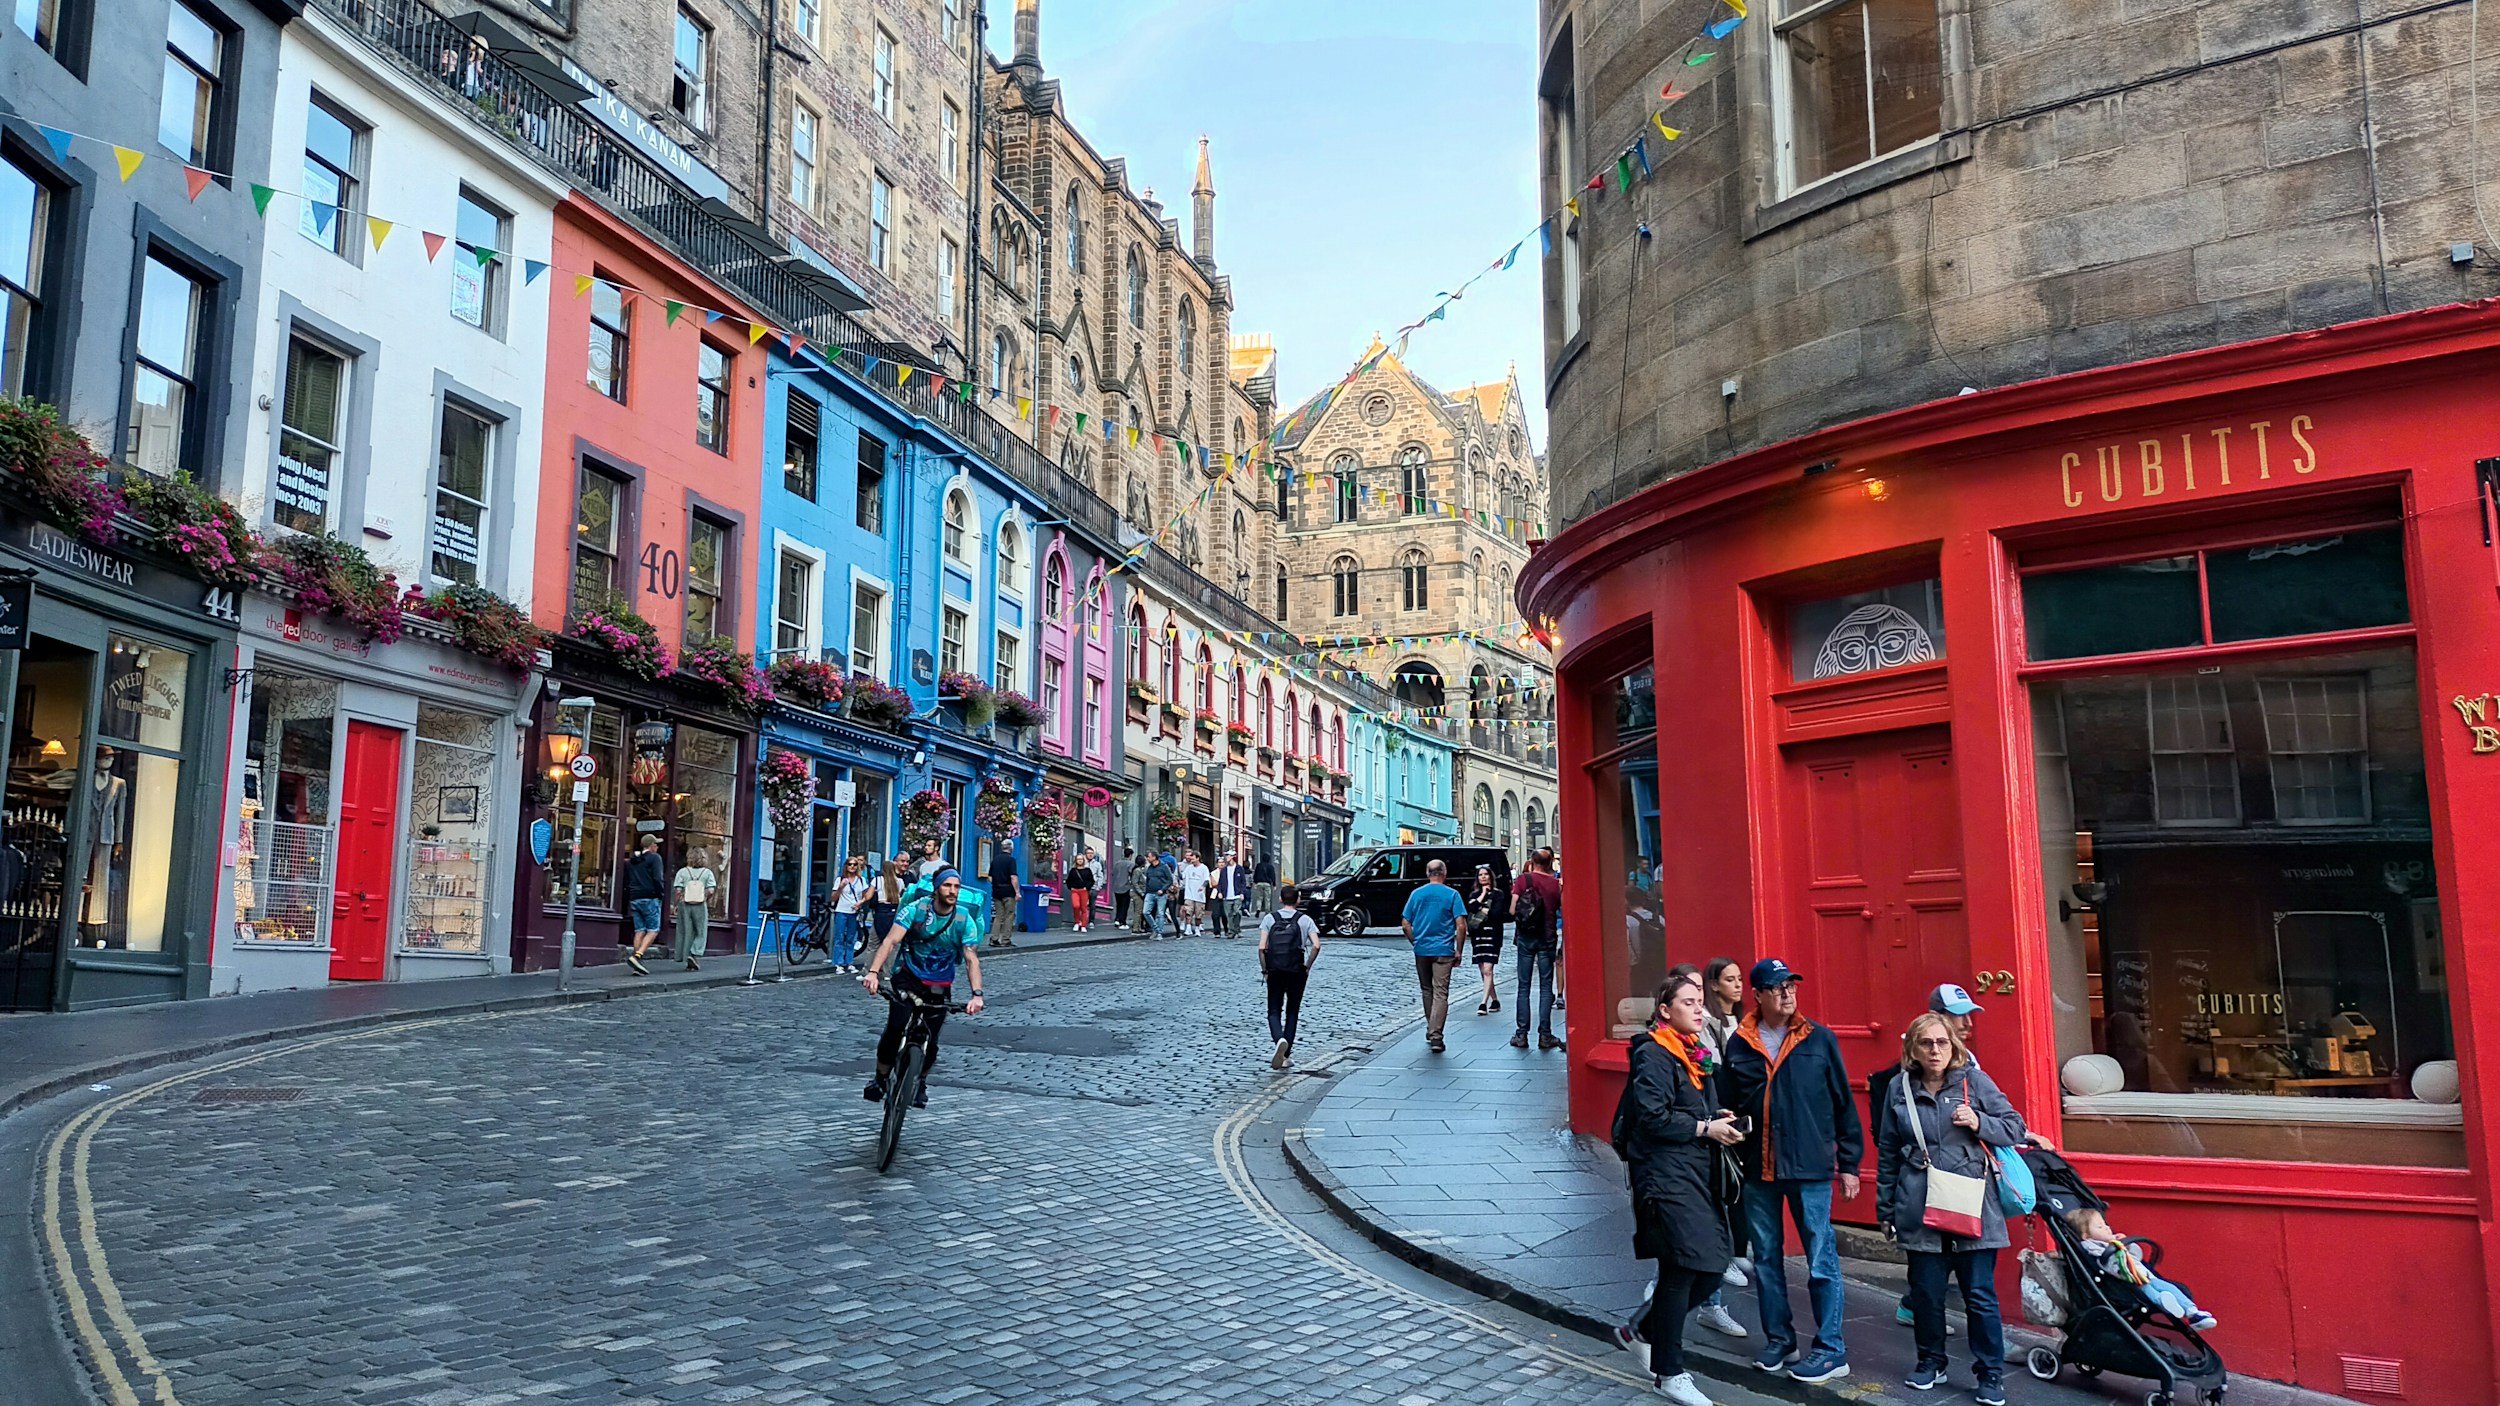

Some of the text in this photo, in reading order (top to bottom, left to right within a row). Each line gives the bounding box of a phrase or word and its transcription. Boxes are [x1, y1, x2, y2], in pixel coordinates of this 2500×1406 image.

[635, 117, 692, 174] KANAM
[279, 454, 302, 475] ving
[302, 462, 327, 484] Local
[2061, 414, 2316, 508] CUBITTS
[275, 485, 322, 516] ince 2003
[280, 472, 298, 490] and
[298, 478, 329, 502] Design
[29, 525, 135, 586] LADIESWEAR
[639, 541, 680, 600] 40
[265, 614, 371, 658] the red door gallery
[109, 672, 143, 696] TWEED
[428, 663, 505, 689] www.edinburghart.com
[146, 673, 181, 711] LUGGAGE
[116, 697, 172, 721] CHILDRENSWEAR
[573, 760, 594, 773] 20
[1975, 969, 2015, 995] 92
[2197, 993, 2284, 1015] CUBITTS
